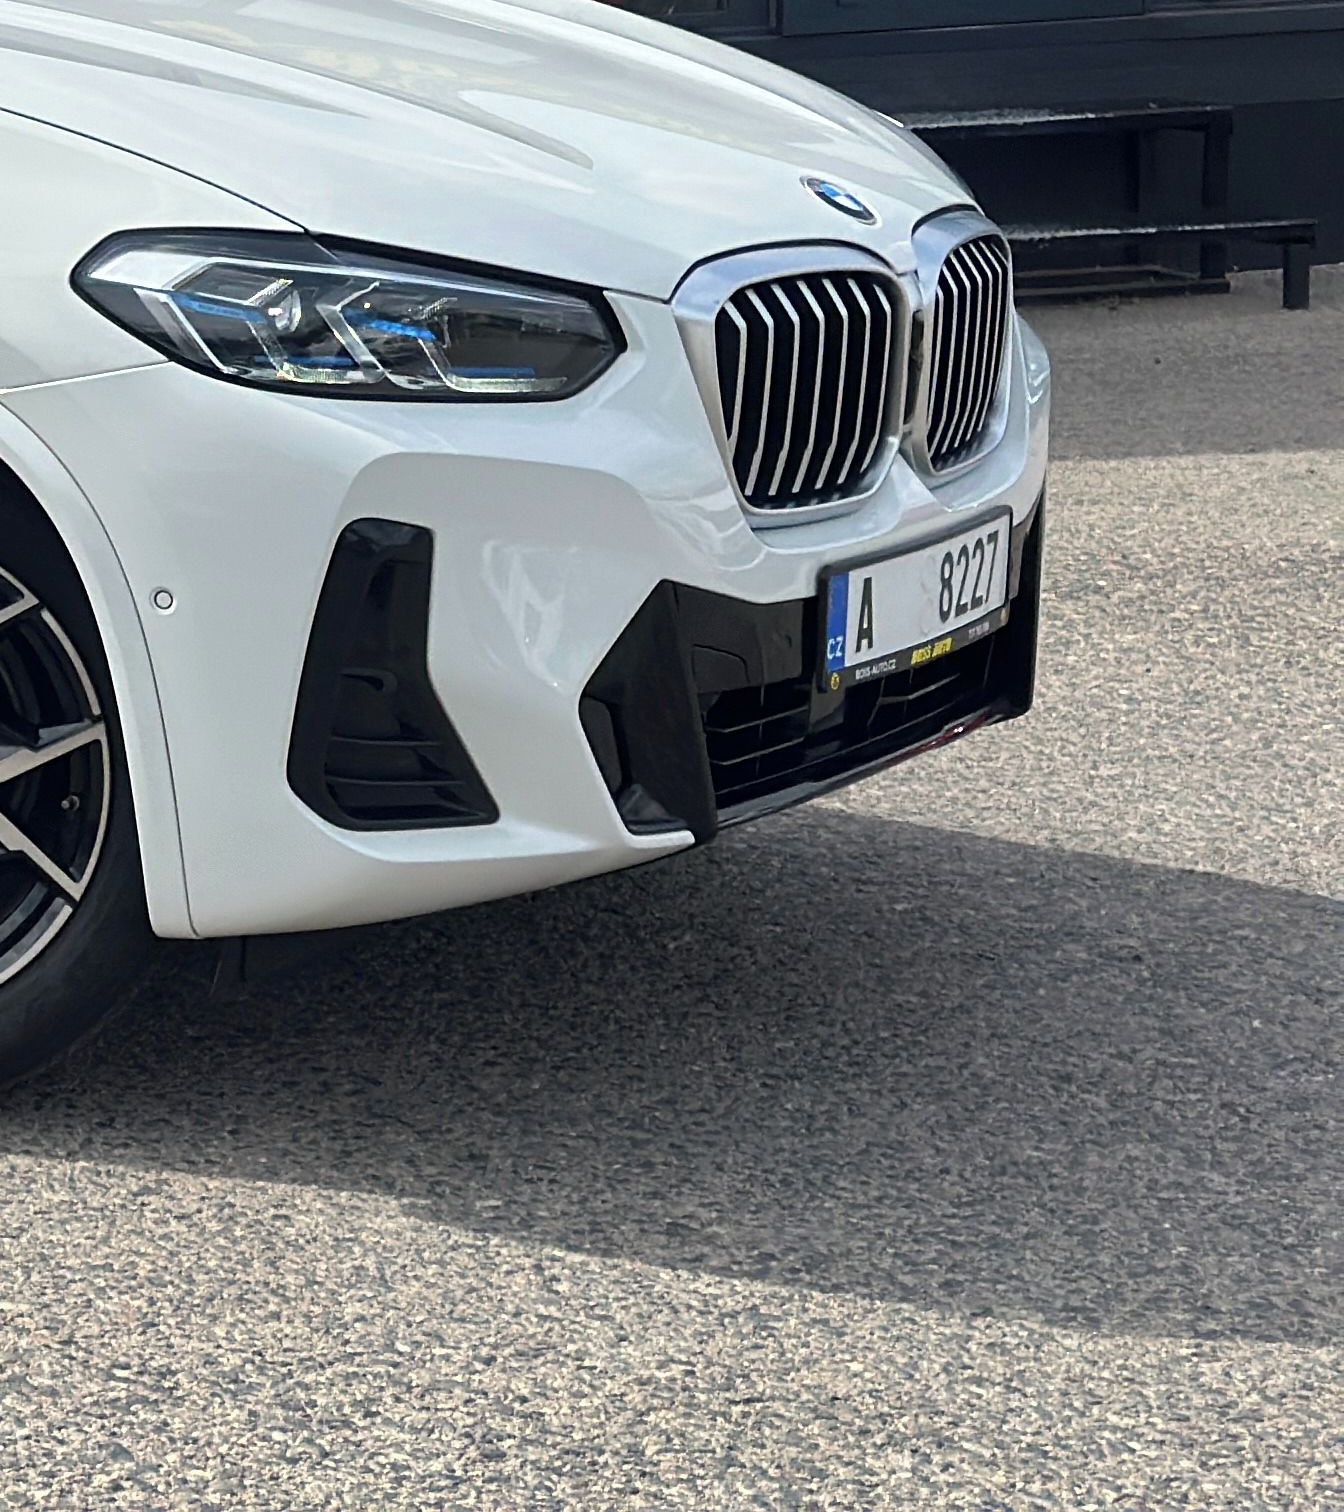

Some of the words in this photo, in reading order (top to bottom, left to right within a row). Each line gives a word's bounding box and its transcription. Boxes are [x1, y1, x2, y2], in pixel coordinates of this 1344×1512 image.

[855, 577, 874, 653] A
[939, 530, 999, 624] 8227
[827, 636, 844, 659] CZ
